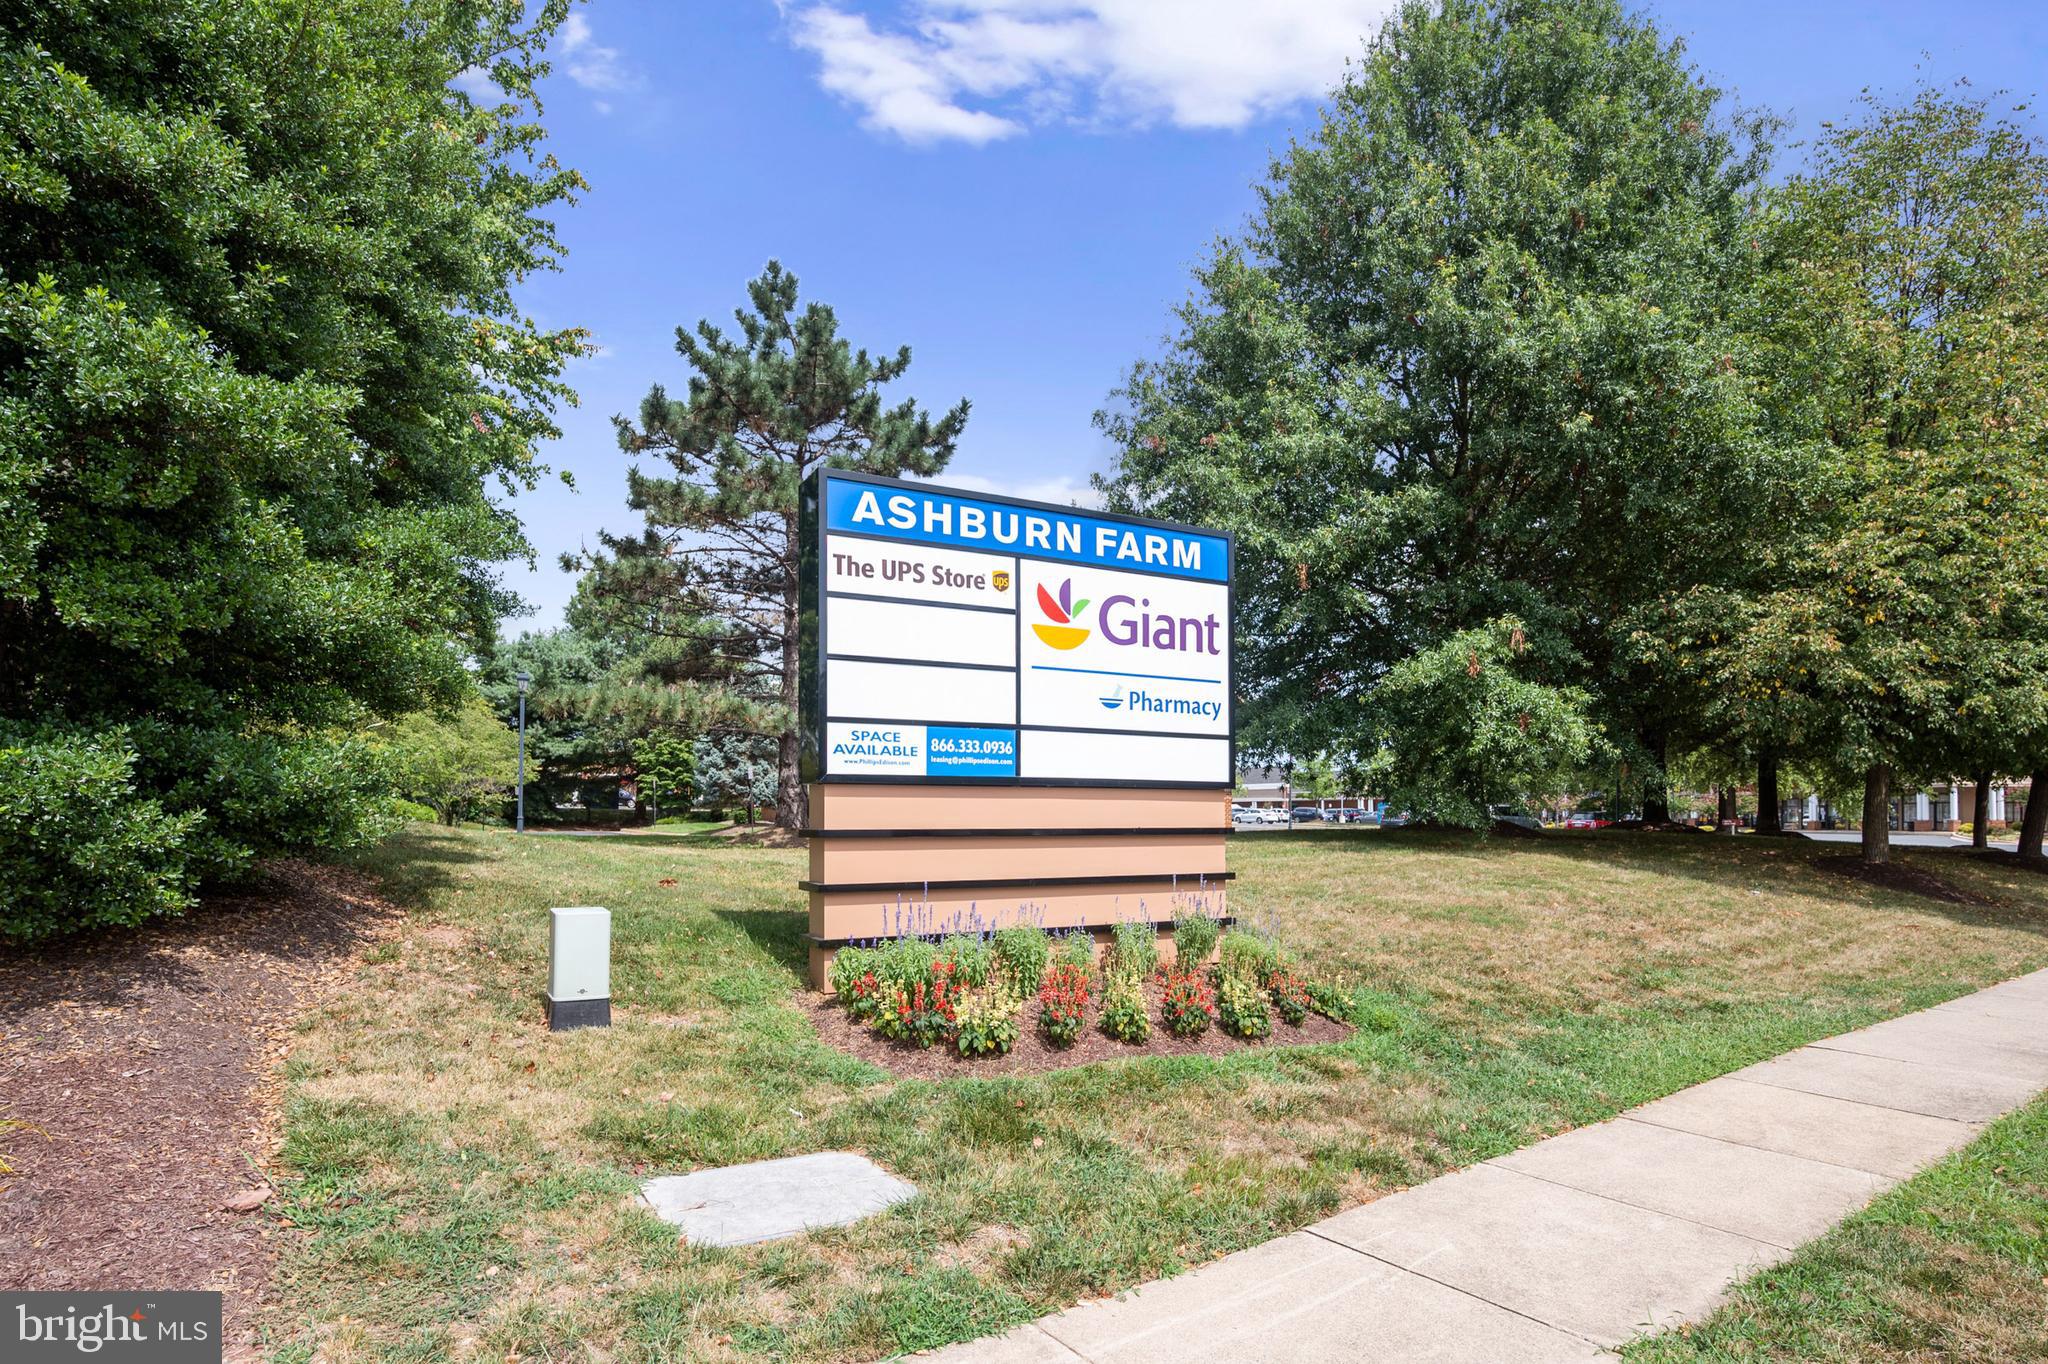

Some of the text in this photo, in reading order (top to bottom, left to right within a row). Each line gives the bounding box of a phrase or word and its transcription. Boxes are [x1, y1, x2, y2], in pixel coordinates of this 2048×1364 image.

[851, 490, 1202, 571] ASHBURN FARM
[832, 553, 985, 590] The UPS Store
[1098, 594, 1221, 656] Giant
[1128, 691, 1222, 721] Pharmacy
[832, 743, 918, 757] AVAILABLE
[851, 730, 901, 743] SPACE
[930, 738, 1013, 755] 866.333.0936
